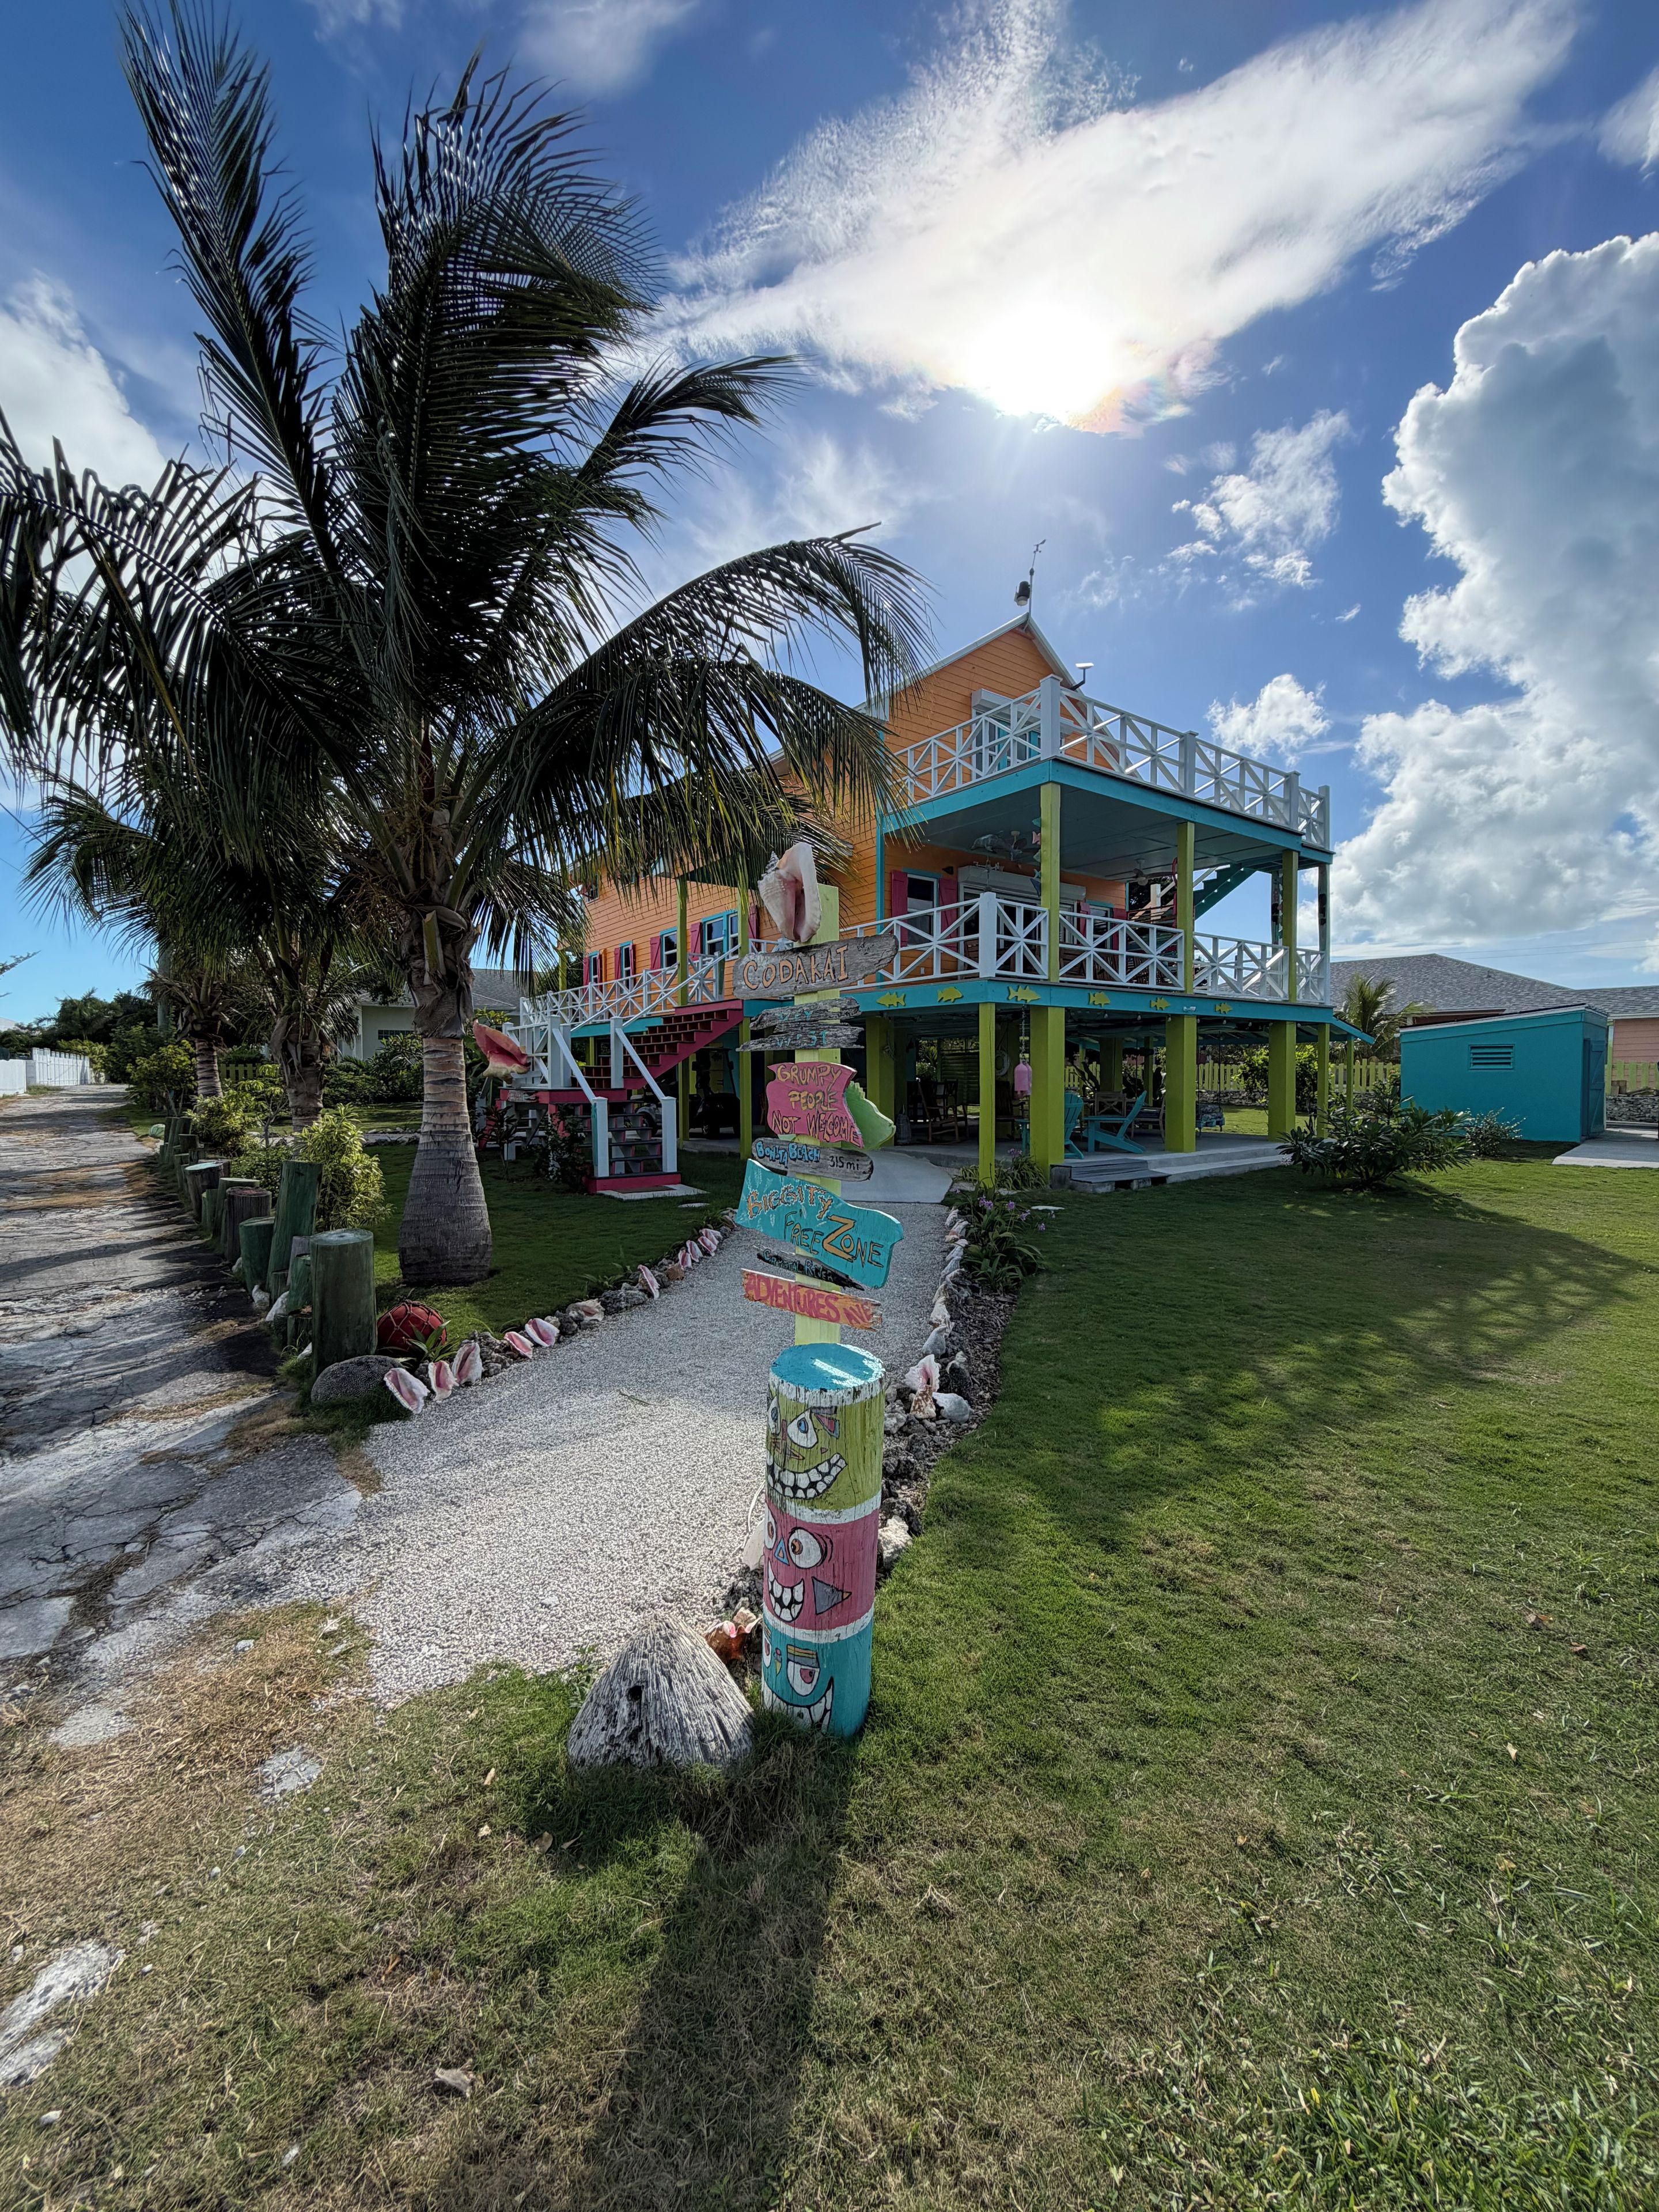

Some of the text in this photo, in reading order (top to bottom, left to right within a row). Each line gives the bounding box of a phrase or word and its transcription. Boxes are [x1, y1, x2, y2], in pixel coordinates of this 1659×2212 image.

[743, 943, 849, 990] CODAKAI
[777, 1029, 829, 1048] WST
[777, 1064, 842, 1092] GRUMPY
[788, 1090, 838, 1112] PEOPLE
[772, 1110, 863, 1148] NOT WELCOME
[756, 1141, 789, 1169] BONITA
[788, 1142, 820, 1162] BEACH
[747, 1184, 834, 1219] BIGGITY
[783, 1211, 884, 1267] FREE ZONE
[763, 1248, 802, 1273] CRYSTAL
[745, 1273, 873, 1325] ADVENTURES AVE
